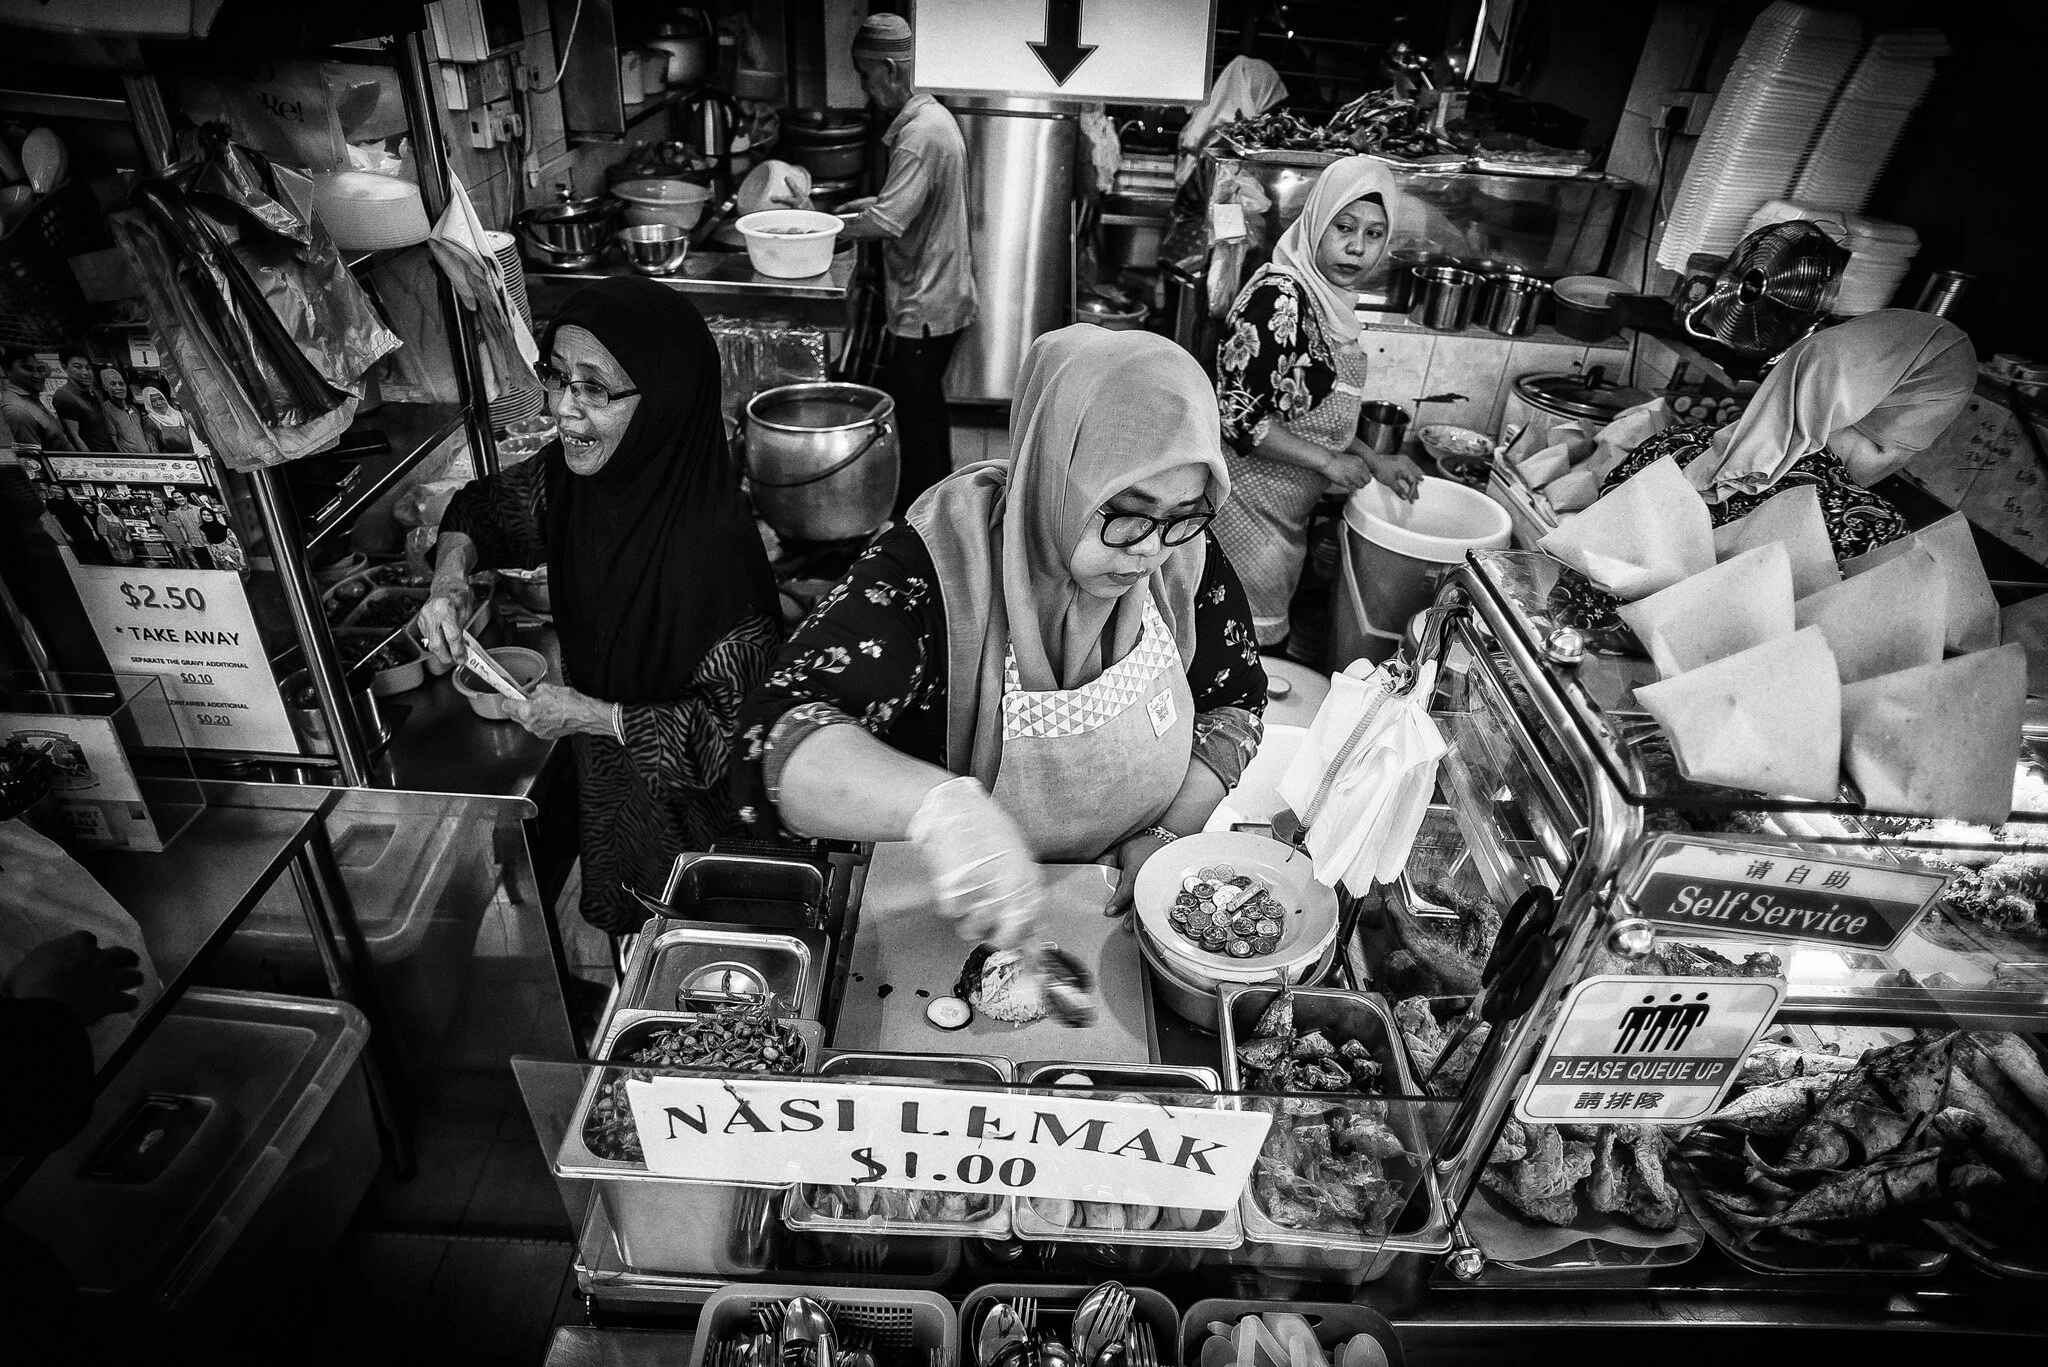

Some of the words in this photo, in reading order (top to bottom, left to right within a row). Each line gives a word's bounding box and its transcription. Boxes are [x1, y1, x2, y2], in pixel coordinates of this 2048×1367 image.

[119, 581, 206, 611] $2.50
[127, 626, 180, 642] TAKE
[184, 629, 239, 646] AWAY
[130, 656, 166, 665] SEPARATE
[206, 660, 249, 669] ADDITIONAL
[180, 672, 214, 685] $0.10
[207, 701, 249, 710] ADDITIONAL
[196, 714, 231, 726] $0.20
[1745, 859, 1851, 889] 请自助
[1667, 886, 1749, 920] Self
[1740, 894, 1868, 935] Service
[1550, 1061, 1626, 1080] PLEASE
[1627, 1062, 1695, 1080] QUEUE
[1694, 1062, 1724, 1081] UP
[1574, 1091, 1665, 1110] 請排隊
[663, 1098, 855, 1140] NASI
[900, 1101, 1227, 1175] LEMAK
[851, 1147, 1036, 1187] $1.00
